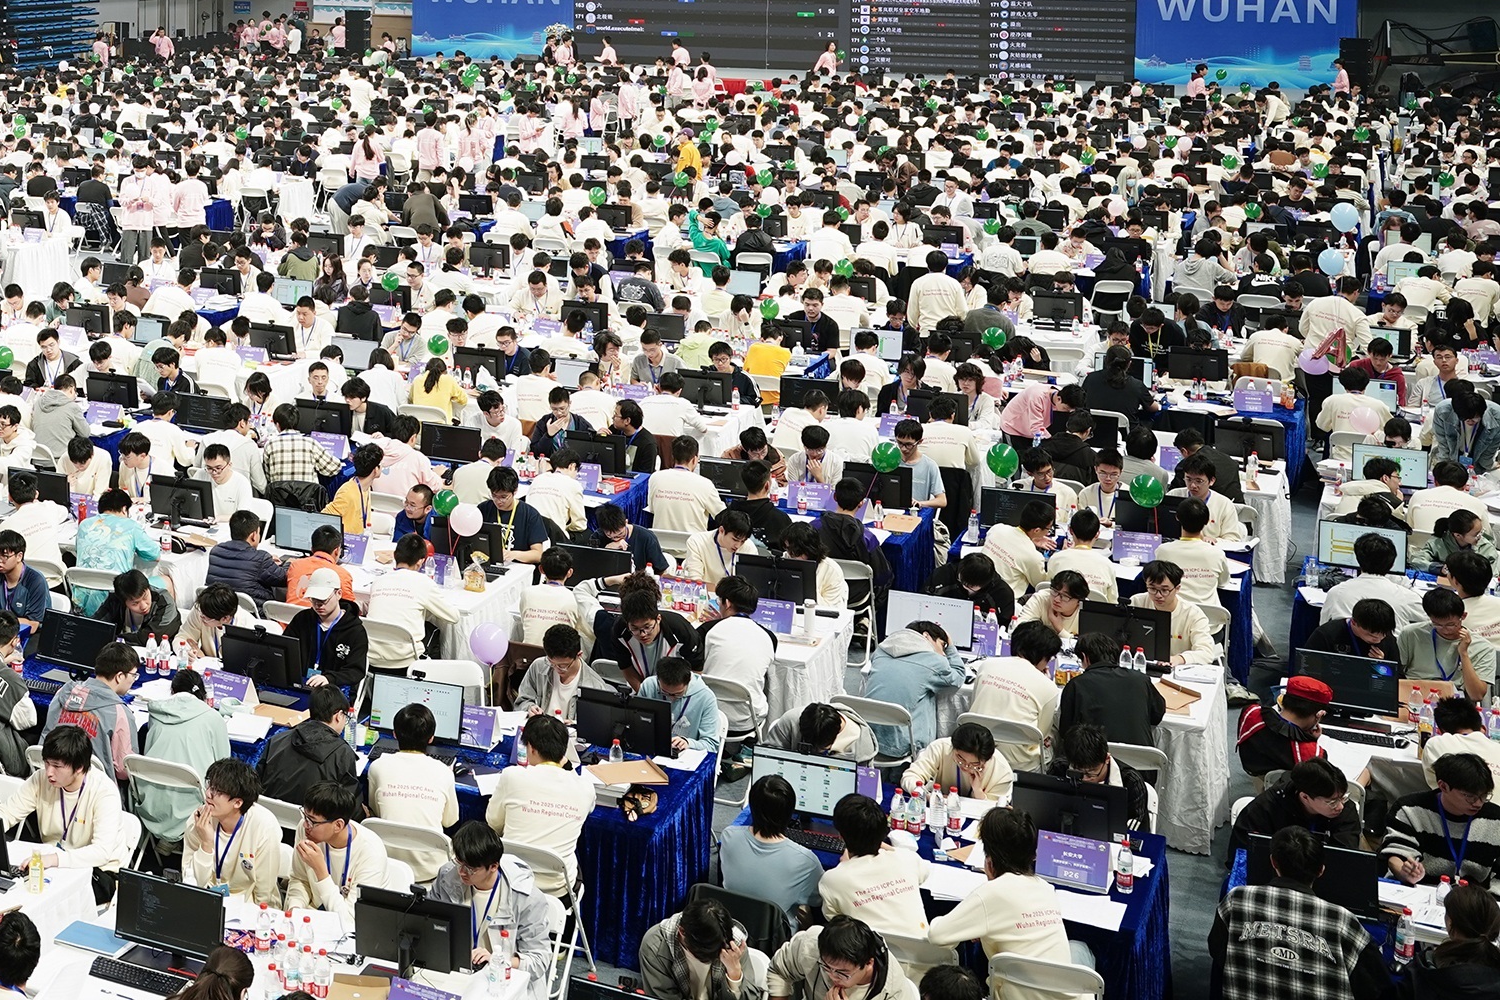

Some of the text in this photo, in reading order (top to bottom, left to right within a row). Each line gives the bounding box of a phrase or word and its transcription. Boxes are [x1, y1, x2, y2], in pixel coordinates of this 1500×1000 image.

[1255, 274, 1277, 282] NIKE
[398, 792, 420, 800] Regional
[541, 808, 564, 817] Regional
[855, 878, 906, 897] The 2025 ICPC Asia
[852, 885, 916, 907] Wuhan Regional Contest
[1015, 920, 1034, 929] Wuhan
[1240, 921, 1336, 964] METSRA
